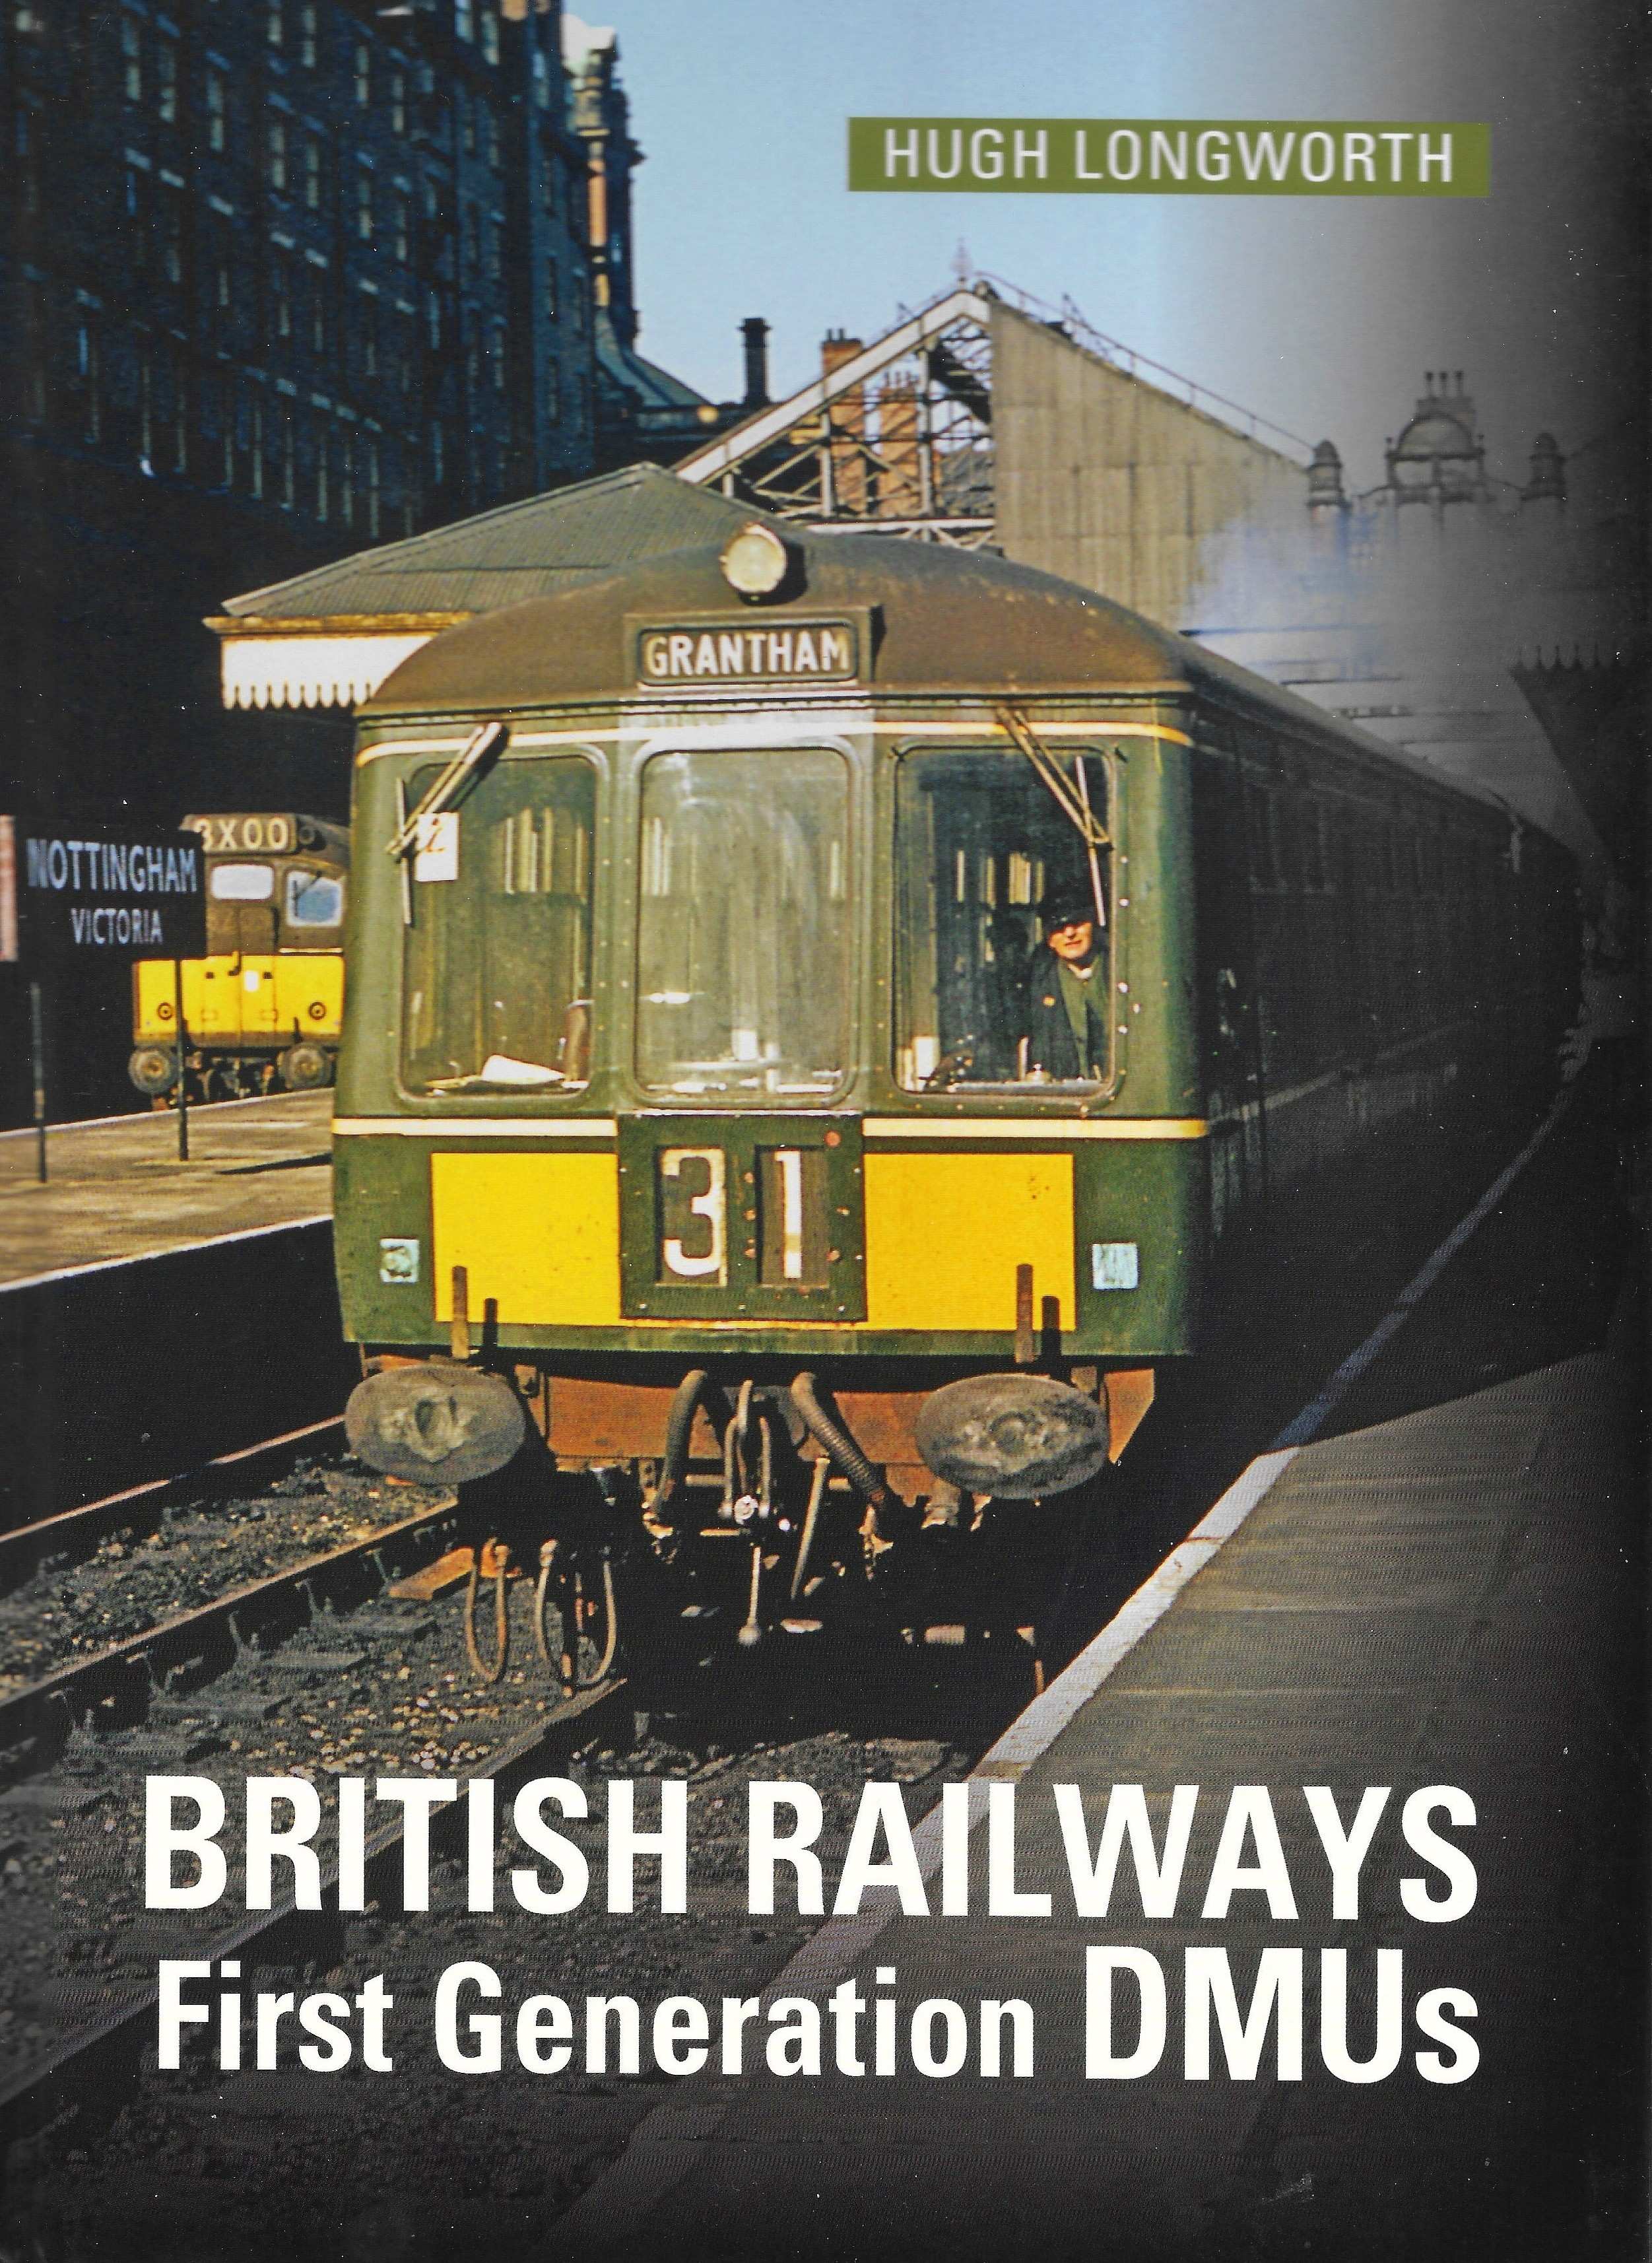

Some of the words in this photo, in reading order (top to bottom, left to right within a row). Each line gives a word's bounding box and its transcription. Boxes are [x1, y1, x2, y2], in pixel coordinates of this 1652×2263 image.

[643, 630, 851, 677] GRANTHAM
[26, 838, 197, 893] NOTTINGHAM
[70, 907, 164, 945] VICTORIA
